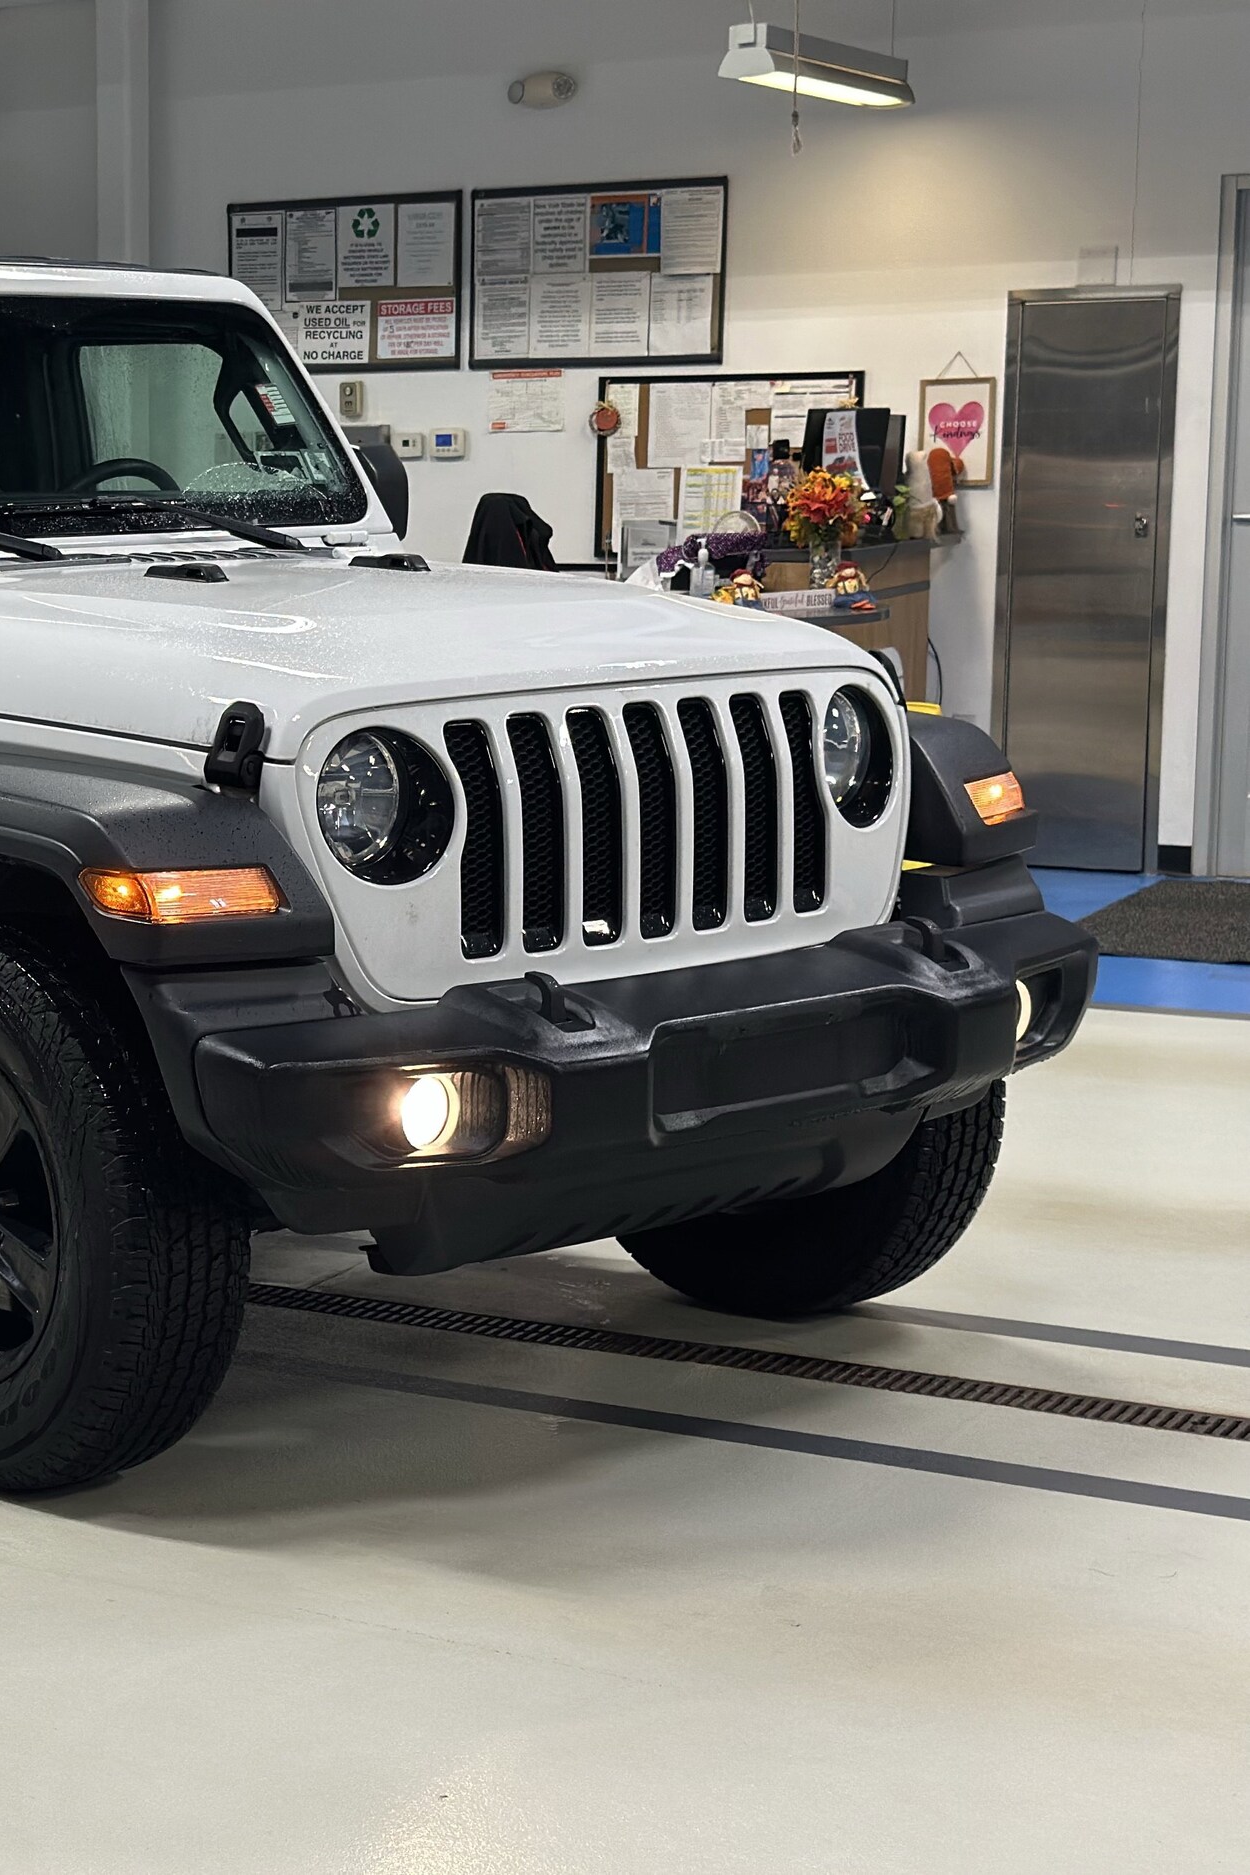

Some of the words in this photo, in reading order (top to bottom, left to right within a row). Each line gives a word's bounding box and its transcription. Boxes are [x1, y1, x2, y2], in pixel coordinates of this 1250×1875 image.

[306, 305, 322, 314] WE
[324, 304, 366, 314] ACCEPT
[380, 303, 426, 315] STORAGE
[427, 301, 452, 313] FEES
[304, 318, 331, 327] USED
[334, 317, 350, 327] OIL
[305, 330, 363, 340] RECYCLING
[303, 351, 318, 360] NO
[321, 350, 364, 360] CHARGE
[939, 420, 978, 429] CHOOSE
[806, 593, 832, 607] BLESSED
